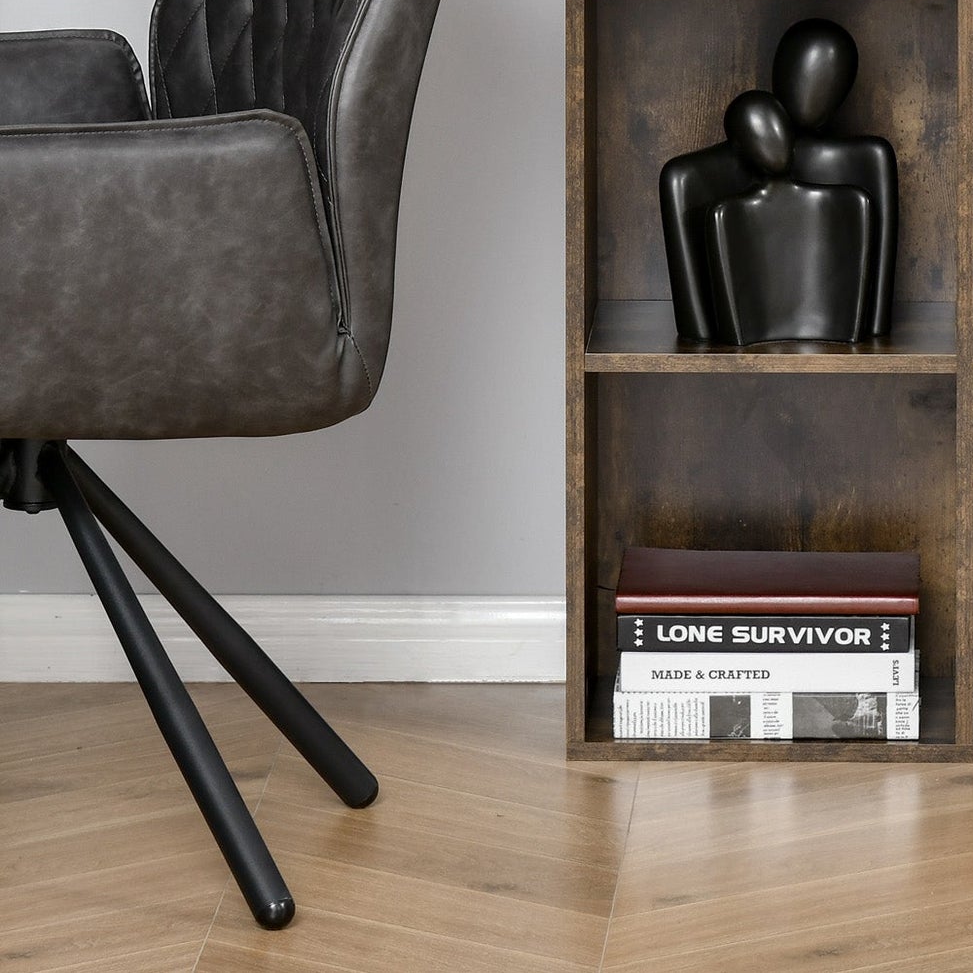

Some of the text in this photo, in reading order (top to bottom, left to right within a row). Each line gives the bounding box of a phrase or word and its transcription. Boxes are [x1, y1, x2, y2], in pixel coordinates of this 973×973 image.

[656, 624, 871, 646] LONE SURVIVOR
[651, 669, 771, 680] MADE & CRAFTED
